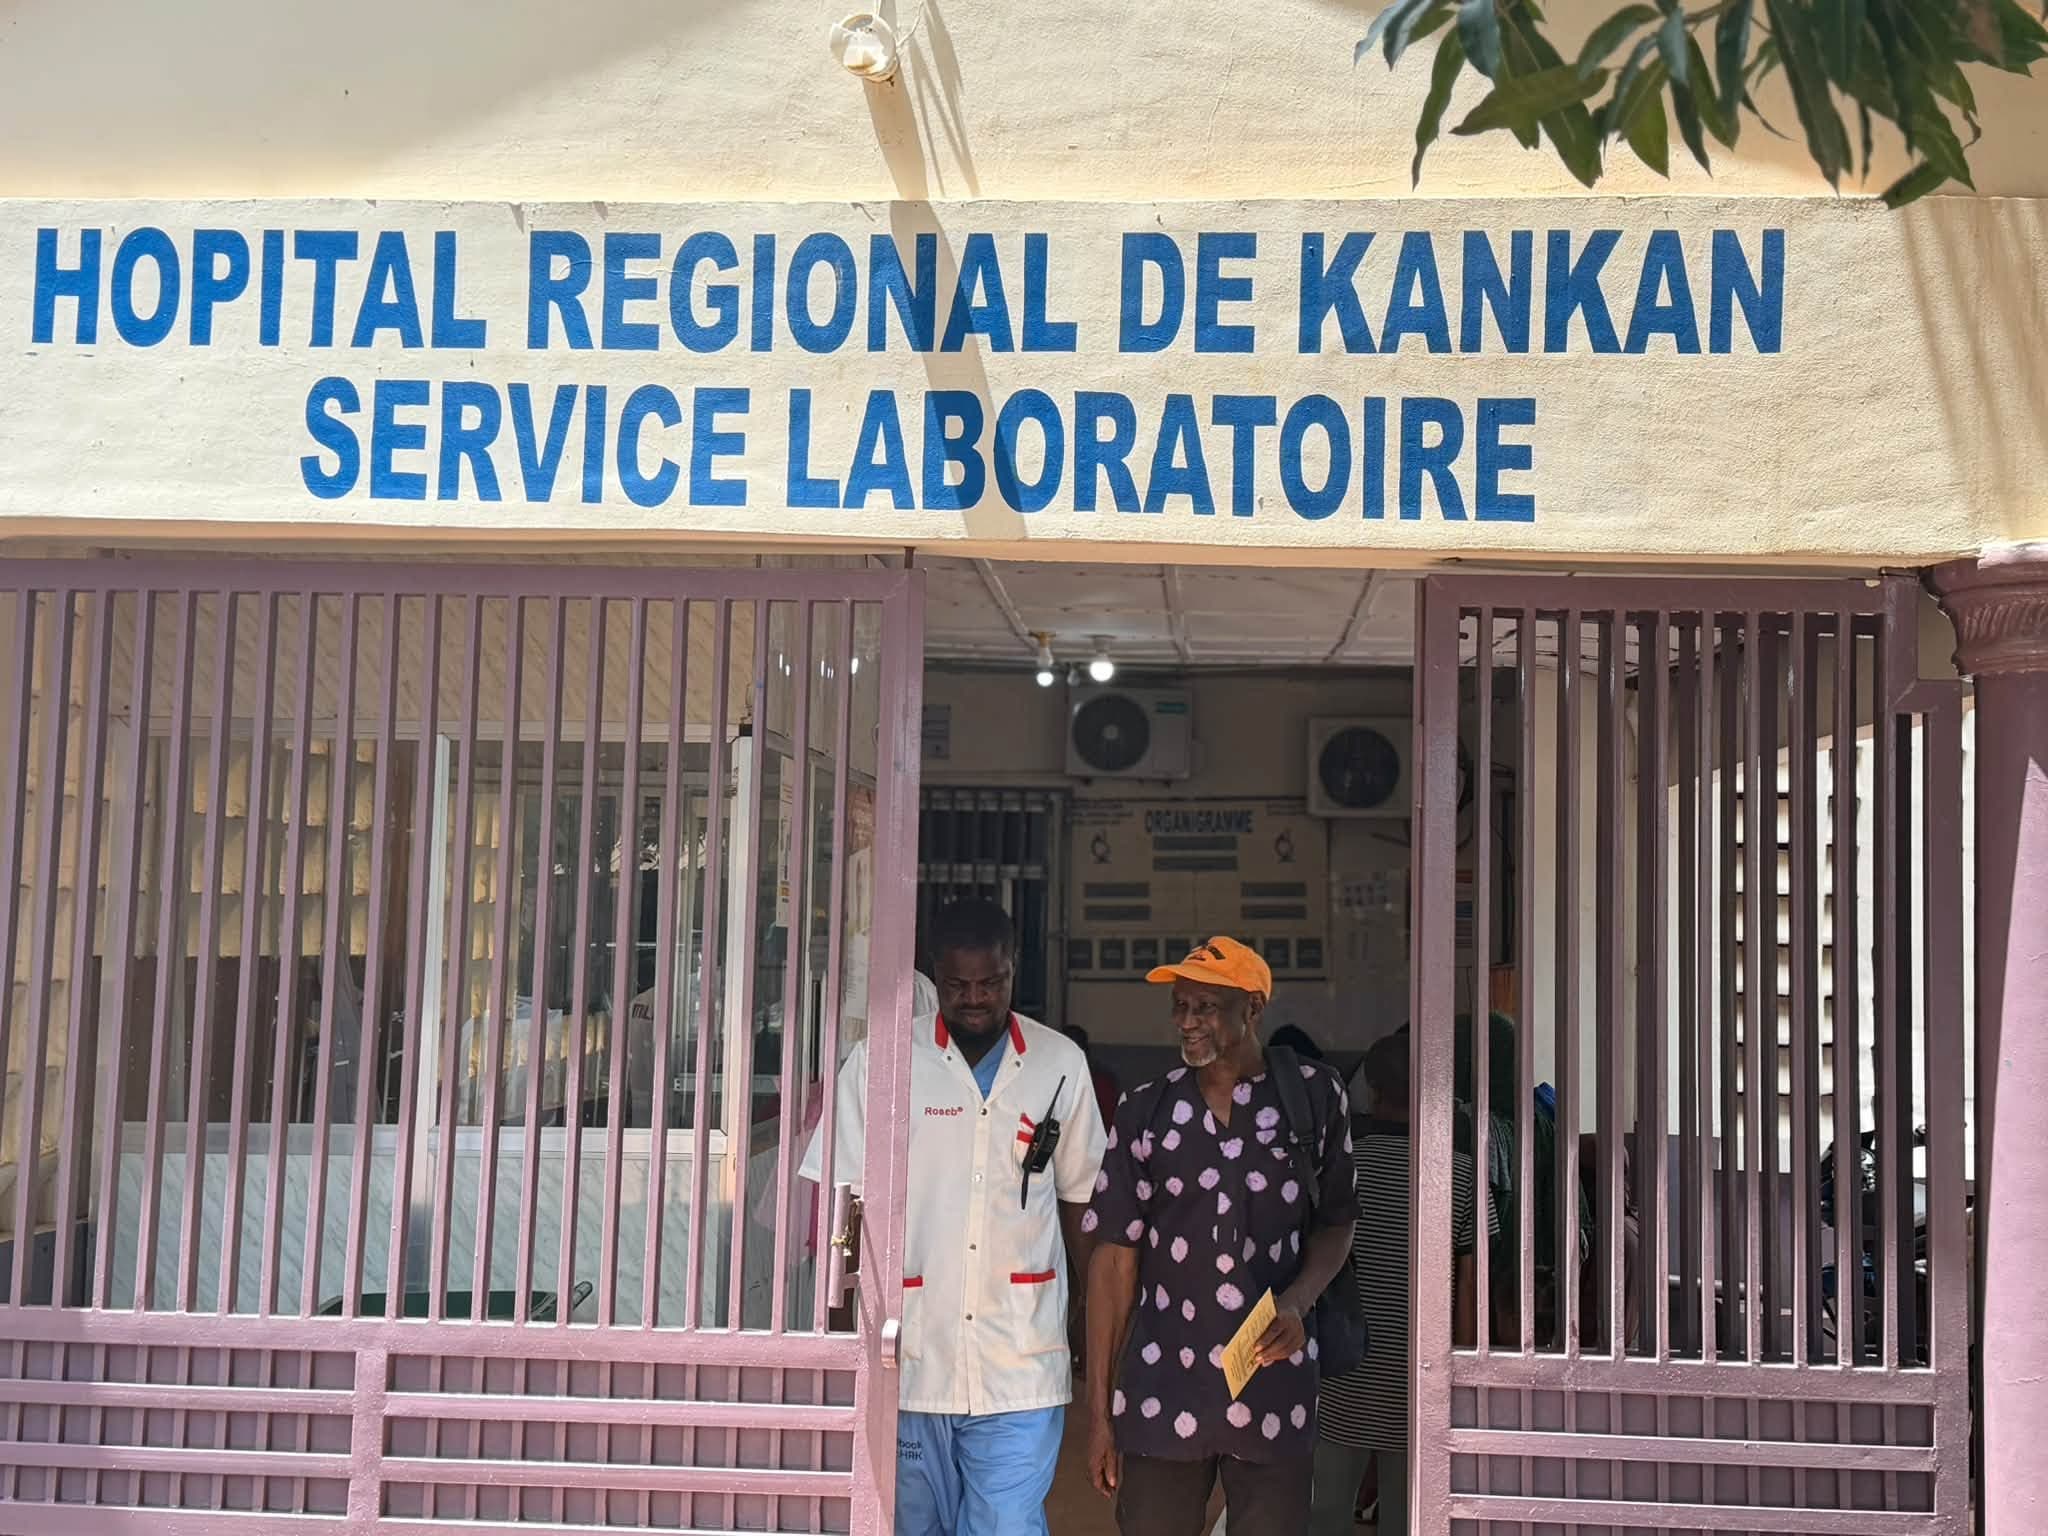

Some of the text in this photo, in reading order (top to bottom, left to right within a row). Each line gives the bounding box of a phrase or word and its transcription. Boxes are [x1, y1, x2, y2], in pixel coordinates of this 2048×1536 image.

[31, 228, 1785, 353] HOPITAL REGIONAL DE KANKAN
[301, 377, 1536, 522] SERVICE LABORATOIRE
